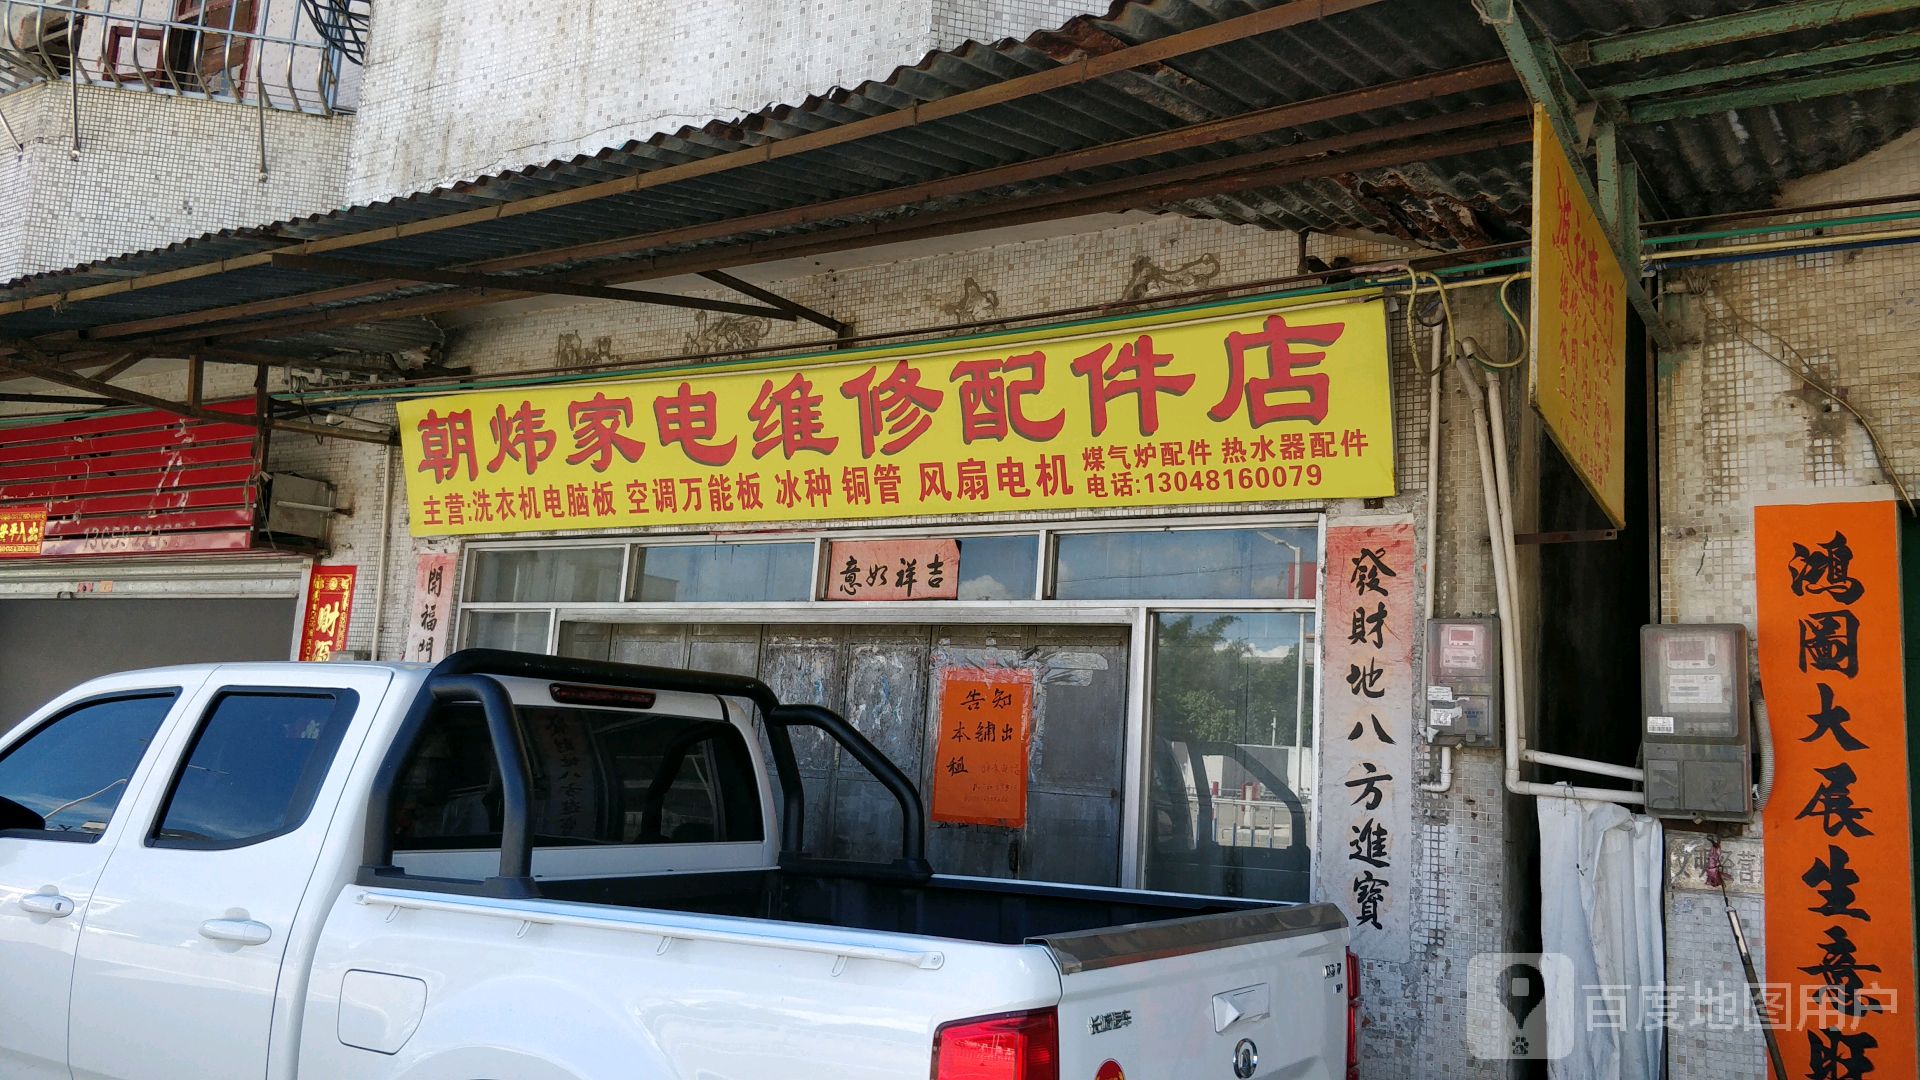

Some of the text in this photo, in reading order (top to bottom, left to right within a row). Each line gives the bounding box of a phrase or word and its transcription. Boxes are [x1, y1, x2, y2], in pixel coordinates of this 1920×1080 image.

[417, 315, 1346, 484] 朝炜家电维修配件店
[1082, 429, 1369, 472] 煤气炉配件 热水器配件
[626, 472, 762, 515] 空调万能板
[775, 466, 833, 508] 冰种
[842, 461, 902, 506] 铜管
[918, 454, 1074, 503] 风扇电机
[1086, 463, 1323, 498] 电话:13048160079
[960, 688, 1012, 710] 告知
[946, 756, 968, 776] 租
